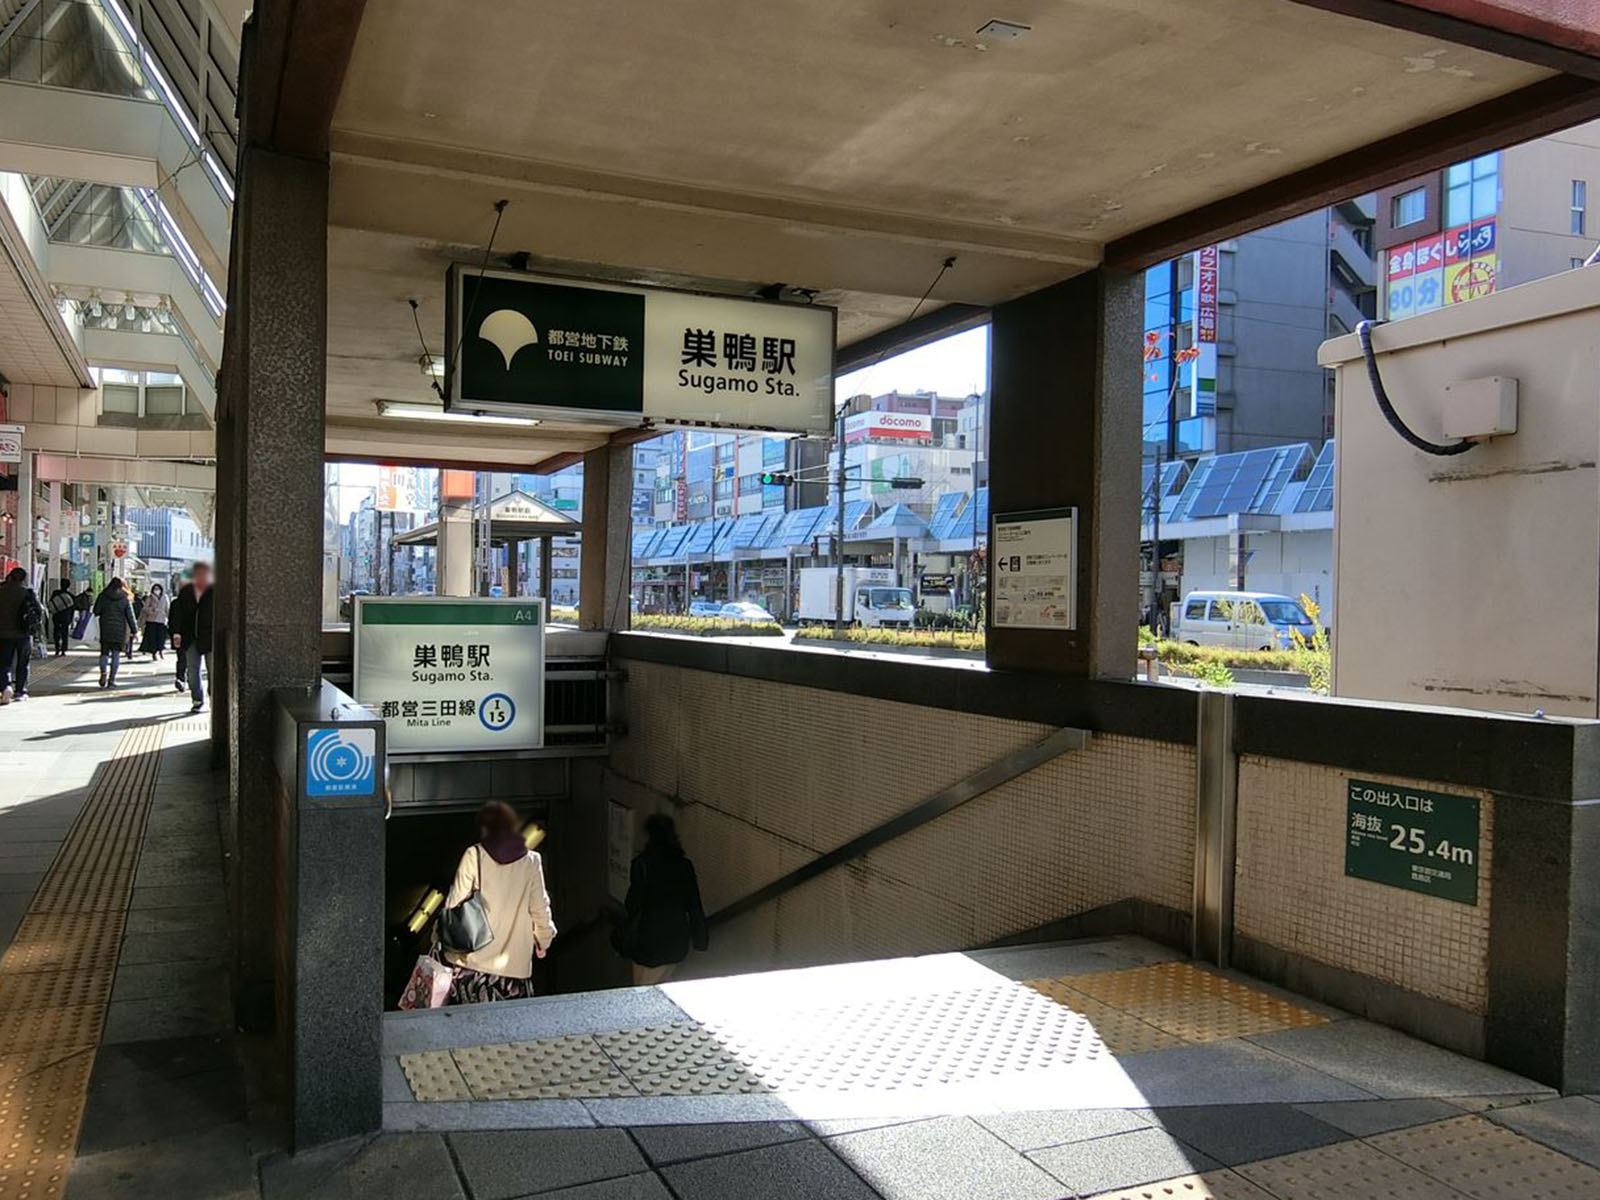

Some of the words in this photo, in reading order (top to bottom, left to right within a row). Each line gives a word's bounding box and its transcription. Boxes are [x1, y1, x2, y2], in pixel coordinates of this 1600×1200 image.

[547, 329, 629, 352] 都営地下鉄
[547, 349, 574, 362] TOEI
[579, 352, 628, 367] SUBWAY
[681, 328, 796, 376] 巣鴨駅
[678, 369, 759, 394] Sugamo
[765, 377, 800, 397] Sta.
[880, 414, 922, 428] docomo
[514, 610, 532, 621] A4
[413, 644, 490, 668] 巣鴨駅
[411, 670, 466, 684] Sugamo
[469, 670, 494, 682] Sta.
[381, 699, 476, 718] 都営三田線
[489, 711, 506, 723] 15
[406, 718, 429, 727] Mita
[431, 717, 452, 727] Line
[1350, 785, 1434, 813] この出入口は
[1351, 812, 1383, 833] 海抜
[1389, 823, 1474, 866] 25.4m
